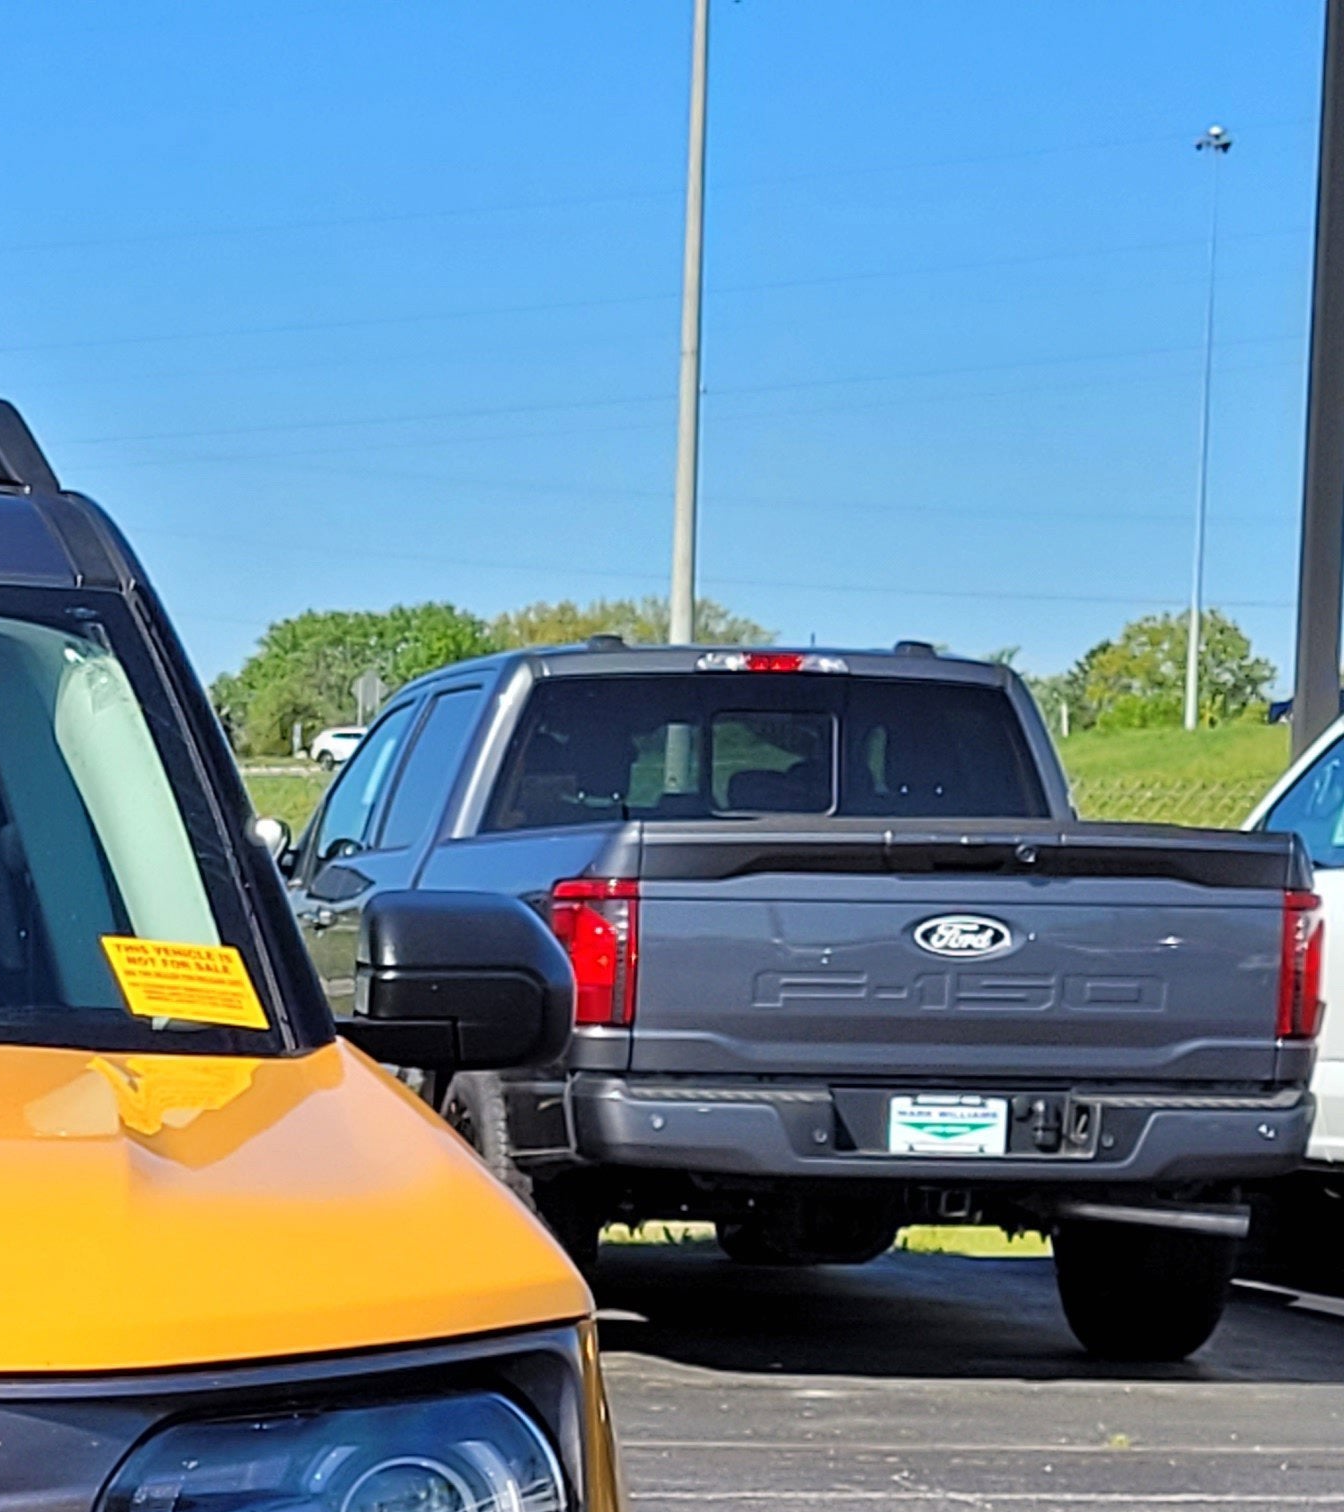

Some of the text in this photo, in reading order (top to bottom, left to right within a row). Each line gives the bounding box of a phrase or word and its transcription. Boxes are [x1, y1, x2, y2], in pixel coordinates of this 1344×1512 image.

[930, 922, 995, 949] Ford
[115, 943, 234, 964] THIS VEHICLE IS
[126, 955, 230, 974] NOT FOR SALE
[751, 970, 1169, 1012] F-150
